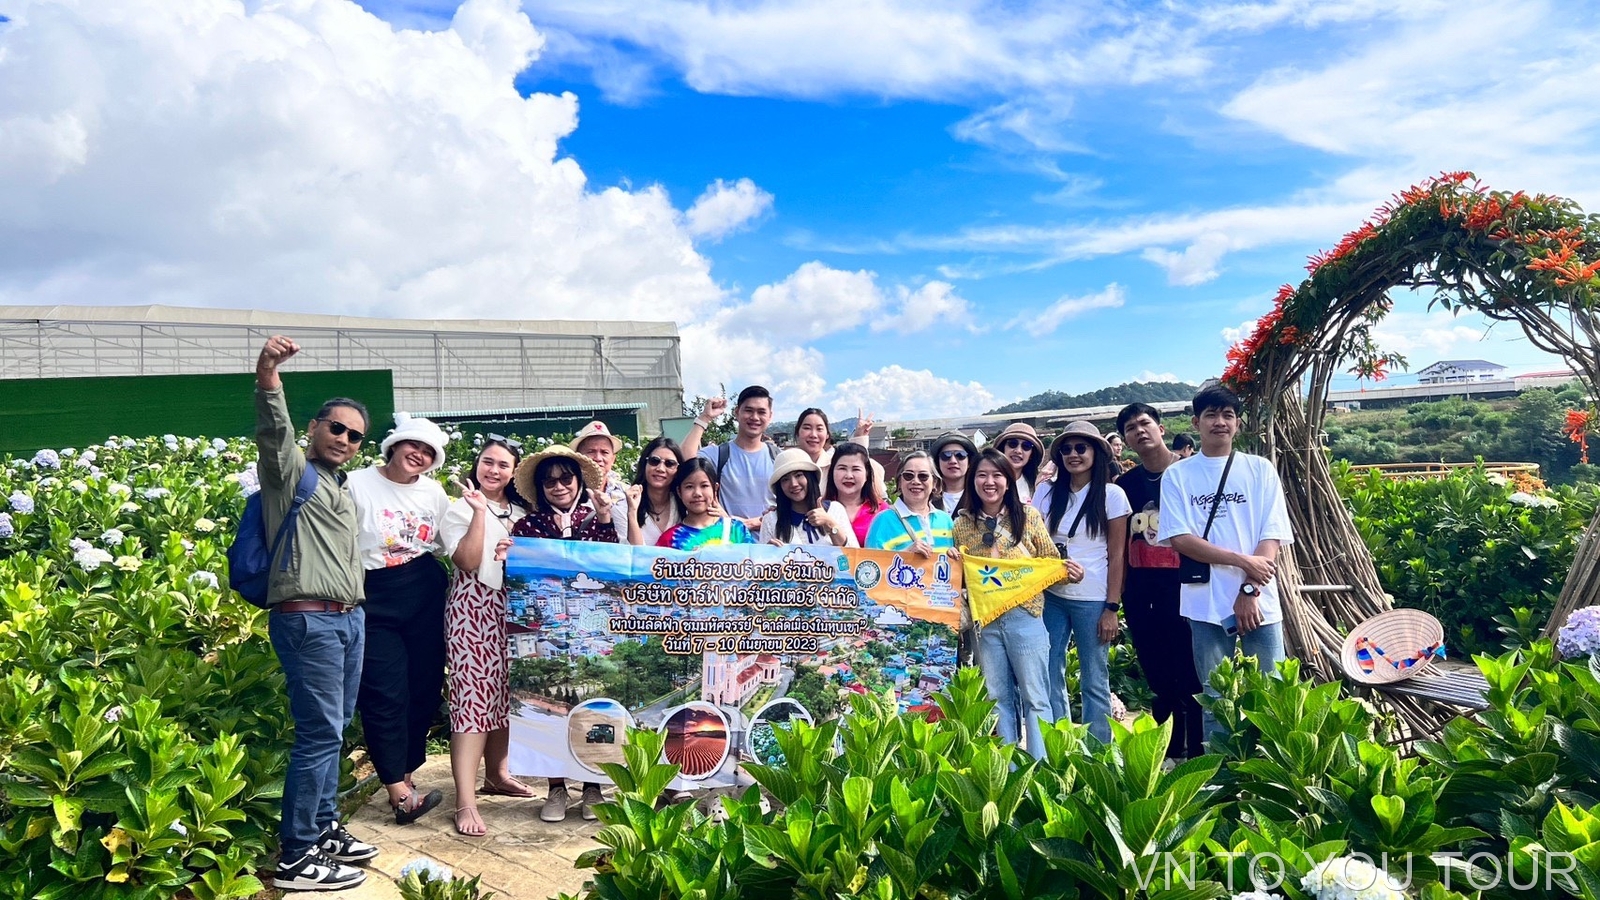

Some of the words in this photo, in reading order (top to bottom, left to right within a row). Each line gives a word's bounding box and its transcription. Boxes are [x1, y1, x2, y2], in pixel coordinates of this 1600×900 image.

[653, 557, 781, 579] ร้านสำรวยบริการ
[784, 560, 833, 580] ร่วมกับ
[623, 584, 672, 605] บริษัท
[723, 585, 815, 609] ฟอร์มูเลเตอร์
[818, 587, 858, 607] จำกัด
[609, 617, 679, 632] พาบินลัดฟ้า
[682, 617, 753, 633] ชมมหัศจรรย์
[665, 634, 691, 652] วันที่
[694, 639, 705, 652] 7
[719, 639, 735, 651] 10
[738, 636, 783, 651] กันยายน
[785, 638, 818, 651] 2023
